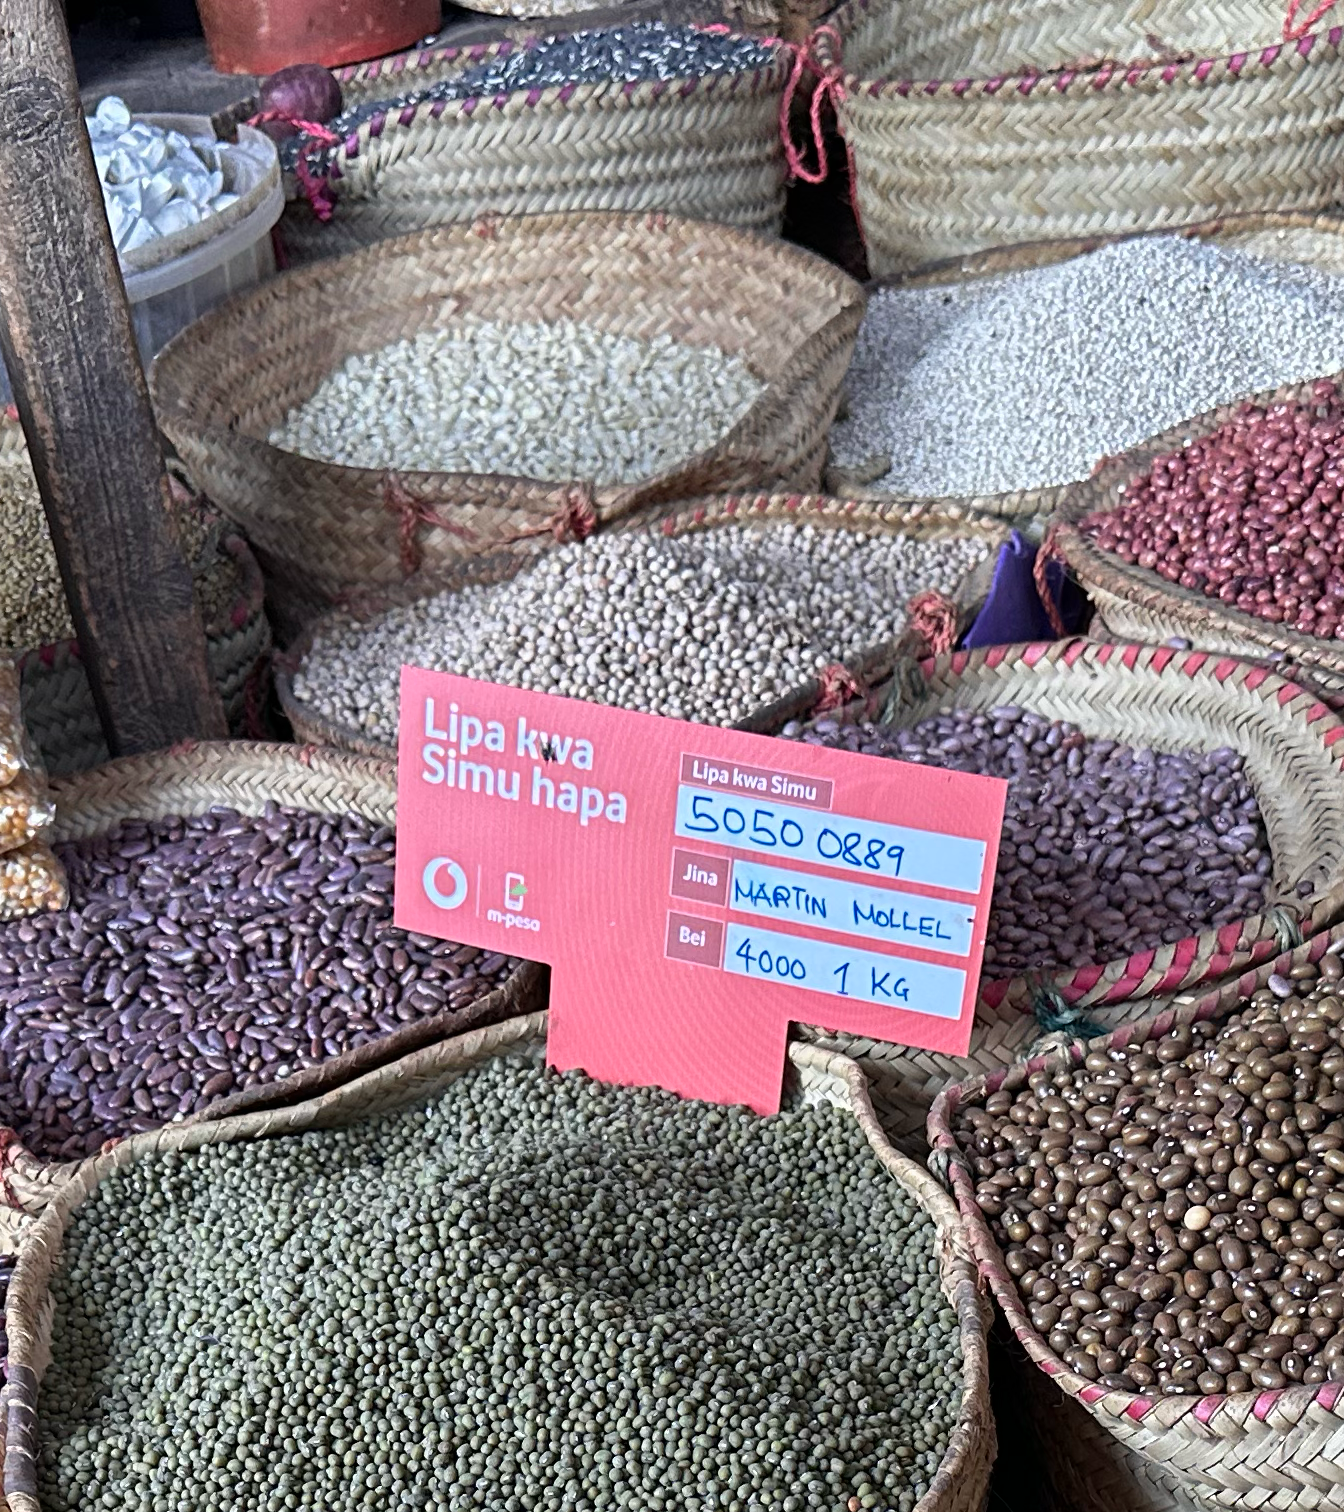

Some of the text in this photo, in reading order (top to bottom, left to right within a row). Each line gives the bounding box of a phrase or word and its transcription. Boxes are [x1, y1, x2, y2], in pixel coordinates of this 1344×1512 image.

[424, 697, 594, 771] Lipa kwa
[422, 743, 628, 826] Simu hapa
[692, 760, 818, 801] Lipa kwa Simu
[684, 795, 905, 877] 5050 0889
[682, 863, 718, 887] Jina
[678, 925, 706, 948] Bei
[734, 878, 952, 940] MARTIN MOLLEL
[736, 937, 910, 1002] 4000 1 KG
